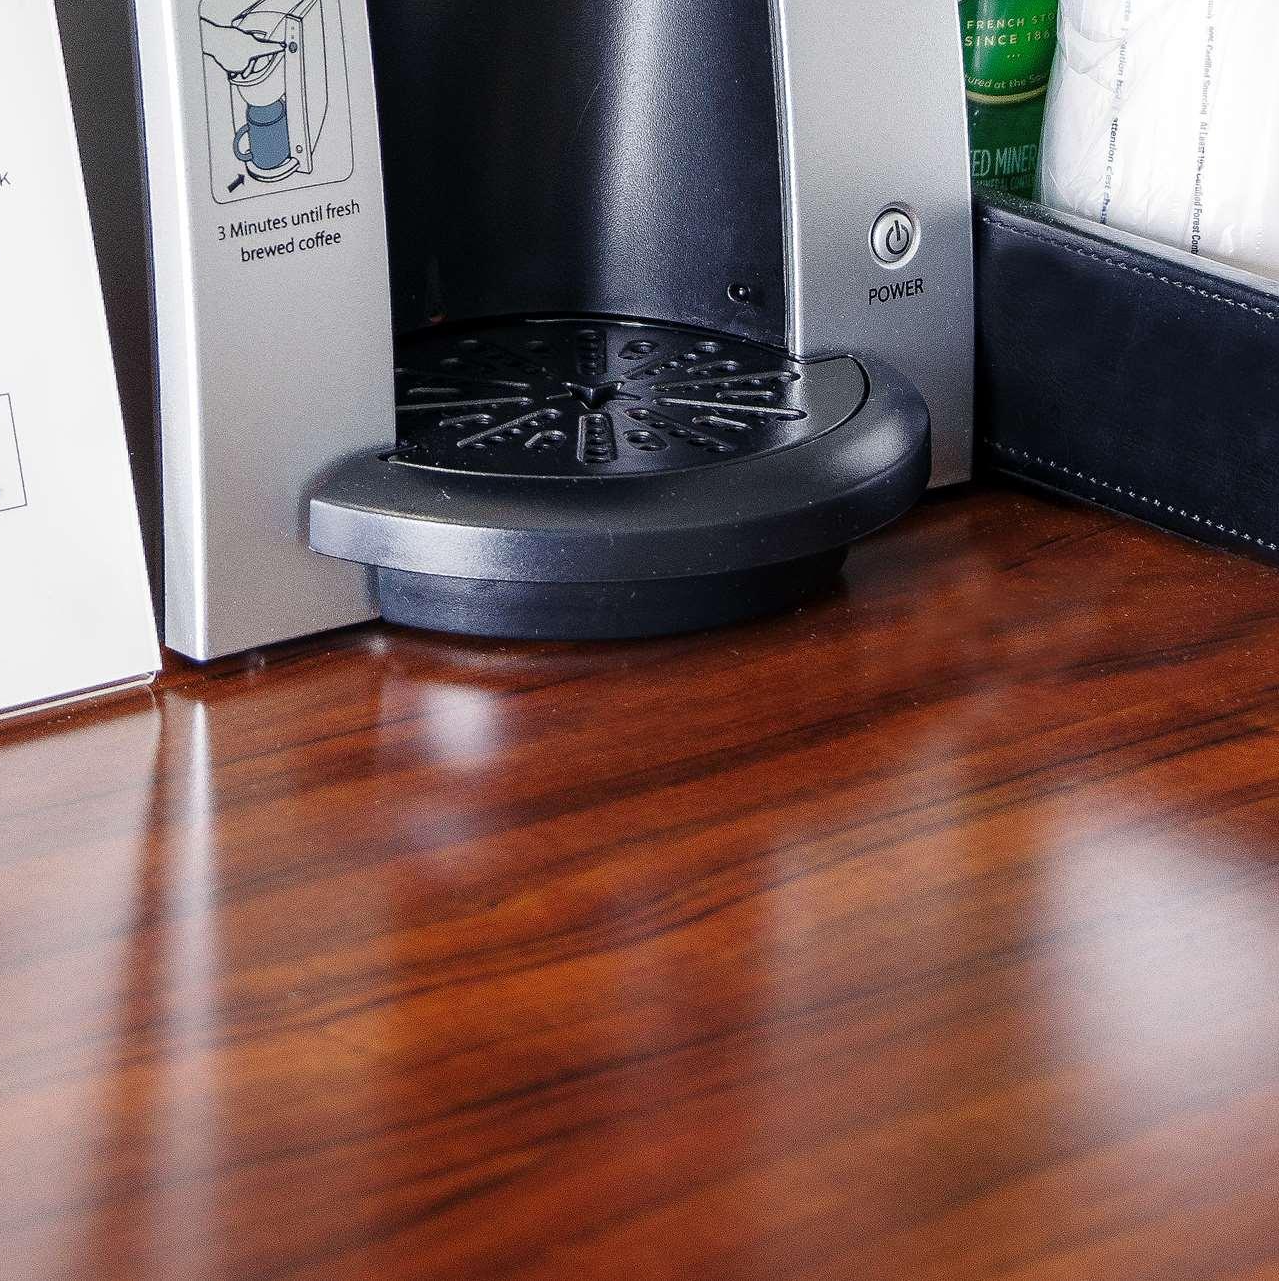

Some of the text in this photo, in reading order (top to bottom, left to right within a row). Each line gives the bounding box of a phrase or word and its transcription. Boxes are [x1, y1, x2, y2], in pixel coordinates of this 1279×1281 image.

[966, 17, 1025, 31] FRENCH
[964, 33, 1018, 47] SINCE
[218, 199, 361, 241] 3 Minutes until fresh
[240, 230, 342, 262] brewed coffee
[868, 278, 924, 306] POWER
